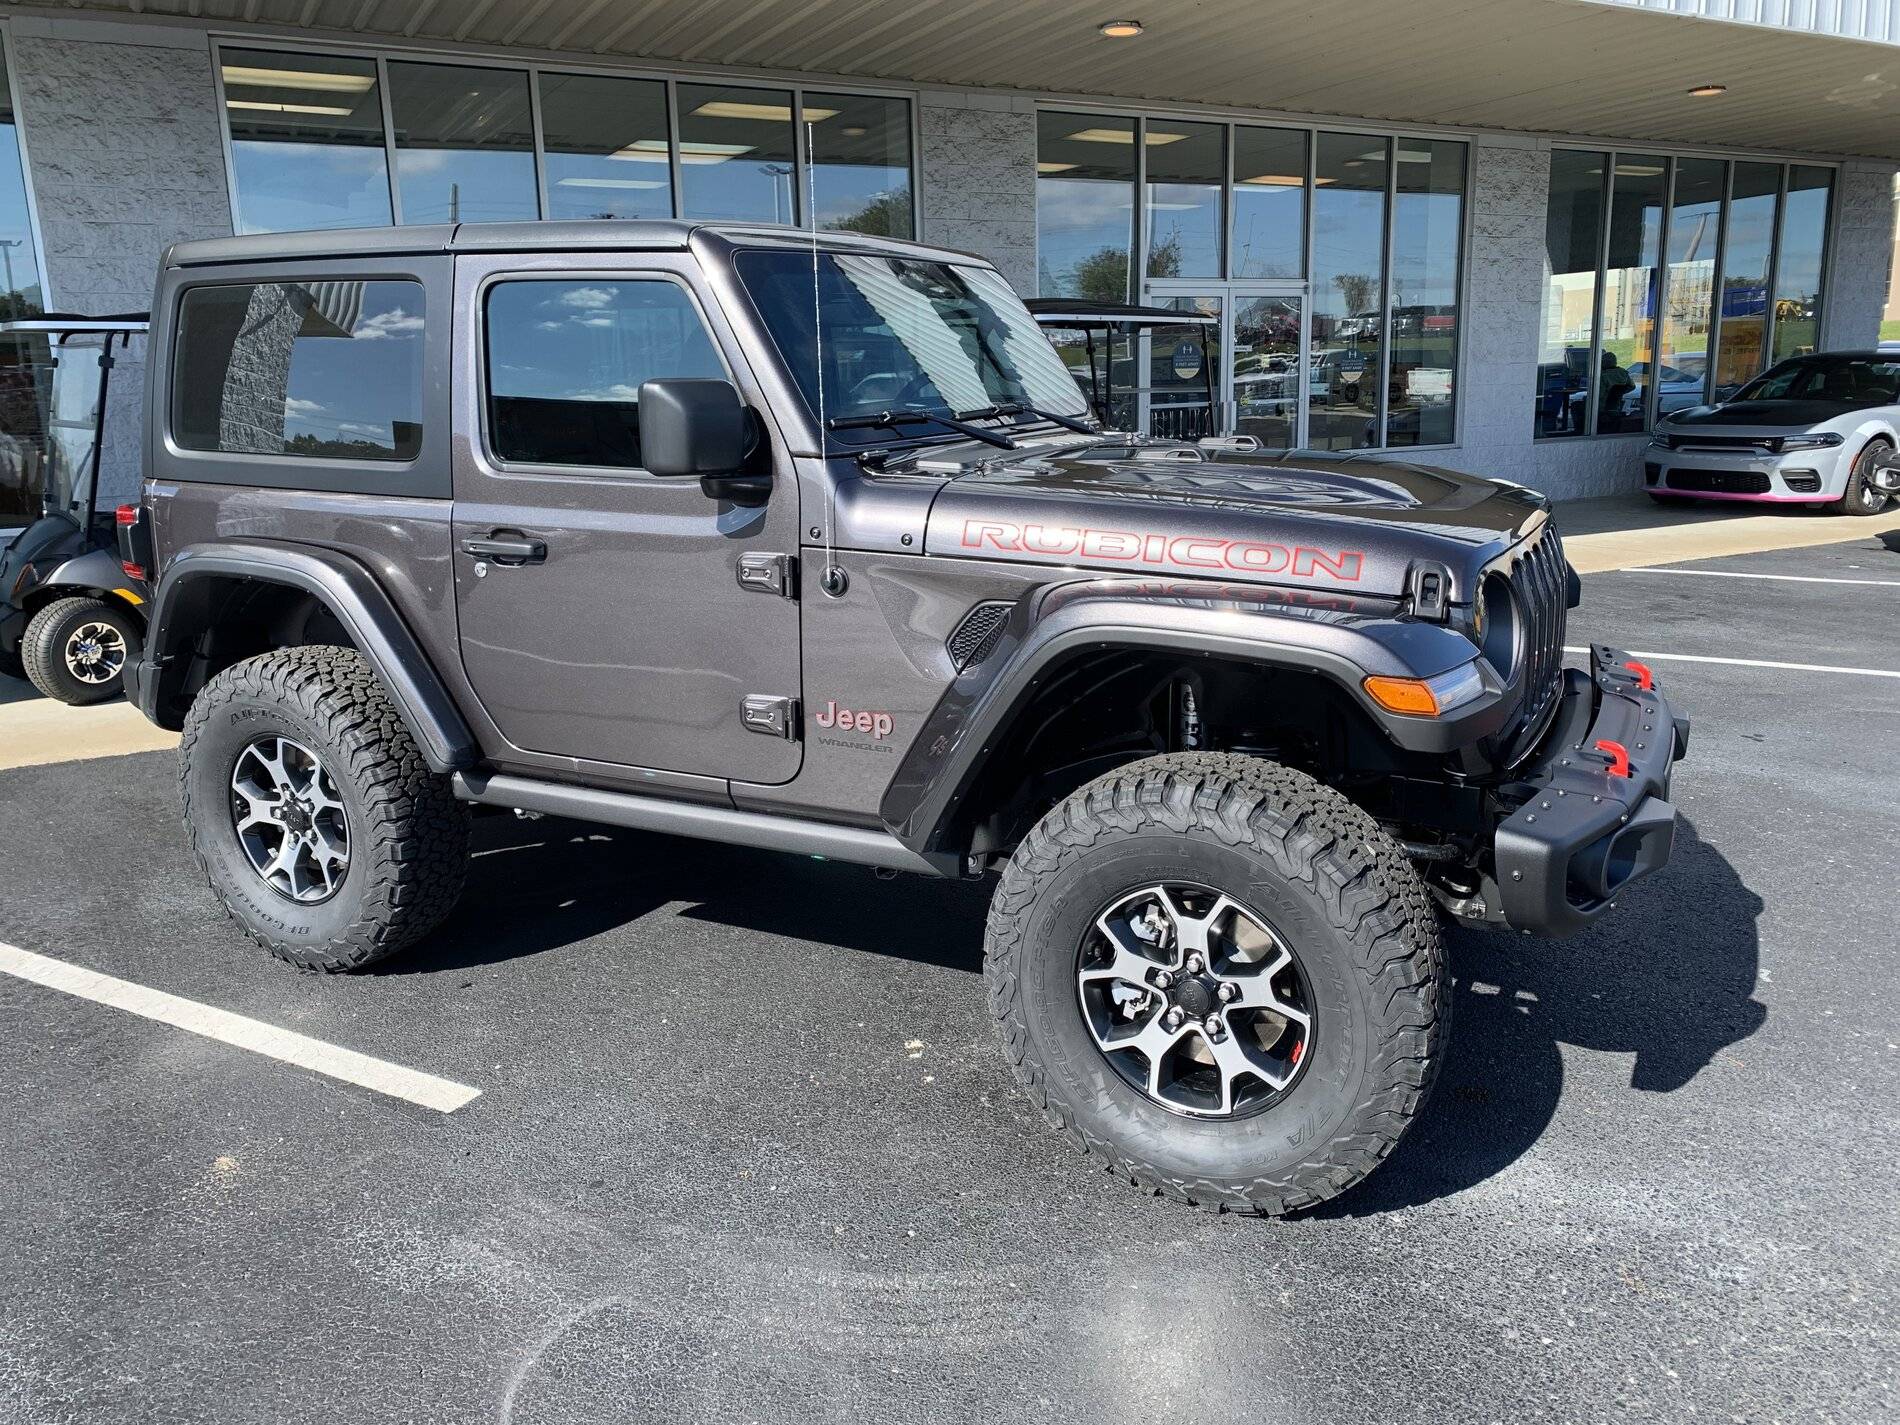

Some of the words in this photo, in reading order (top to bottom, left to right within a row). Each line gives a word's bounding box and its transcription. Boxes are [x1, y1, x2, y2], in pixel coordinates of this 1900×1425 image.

[961, 519, 1364, 581] RUBICON
[815, 700, 894, 740] Jeep
[817, 736, 893, 754] WRANGLER
